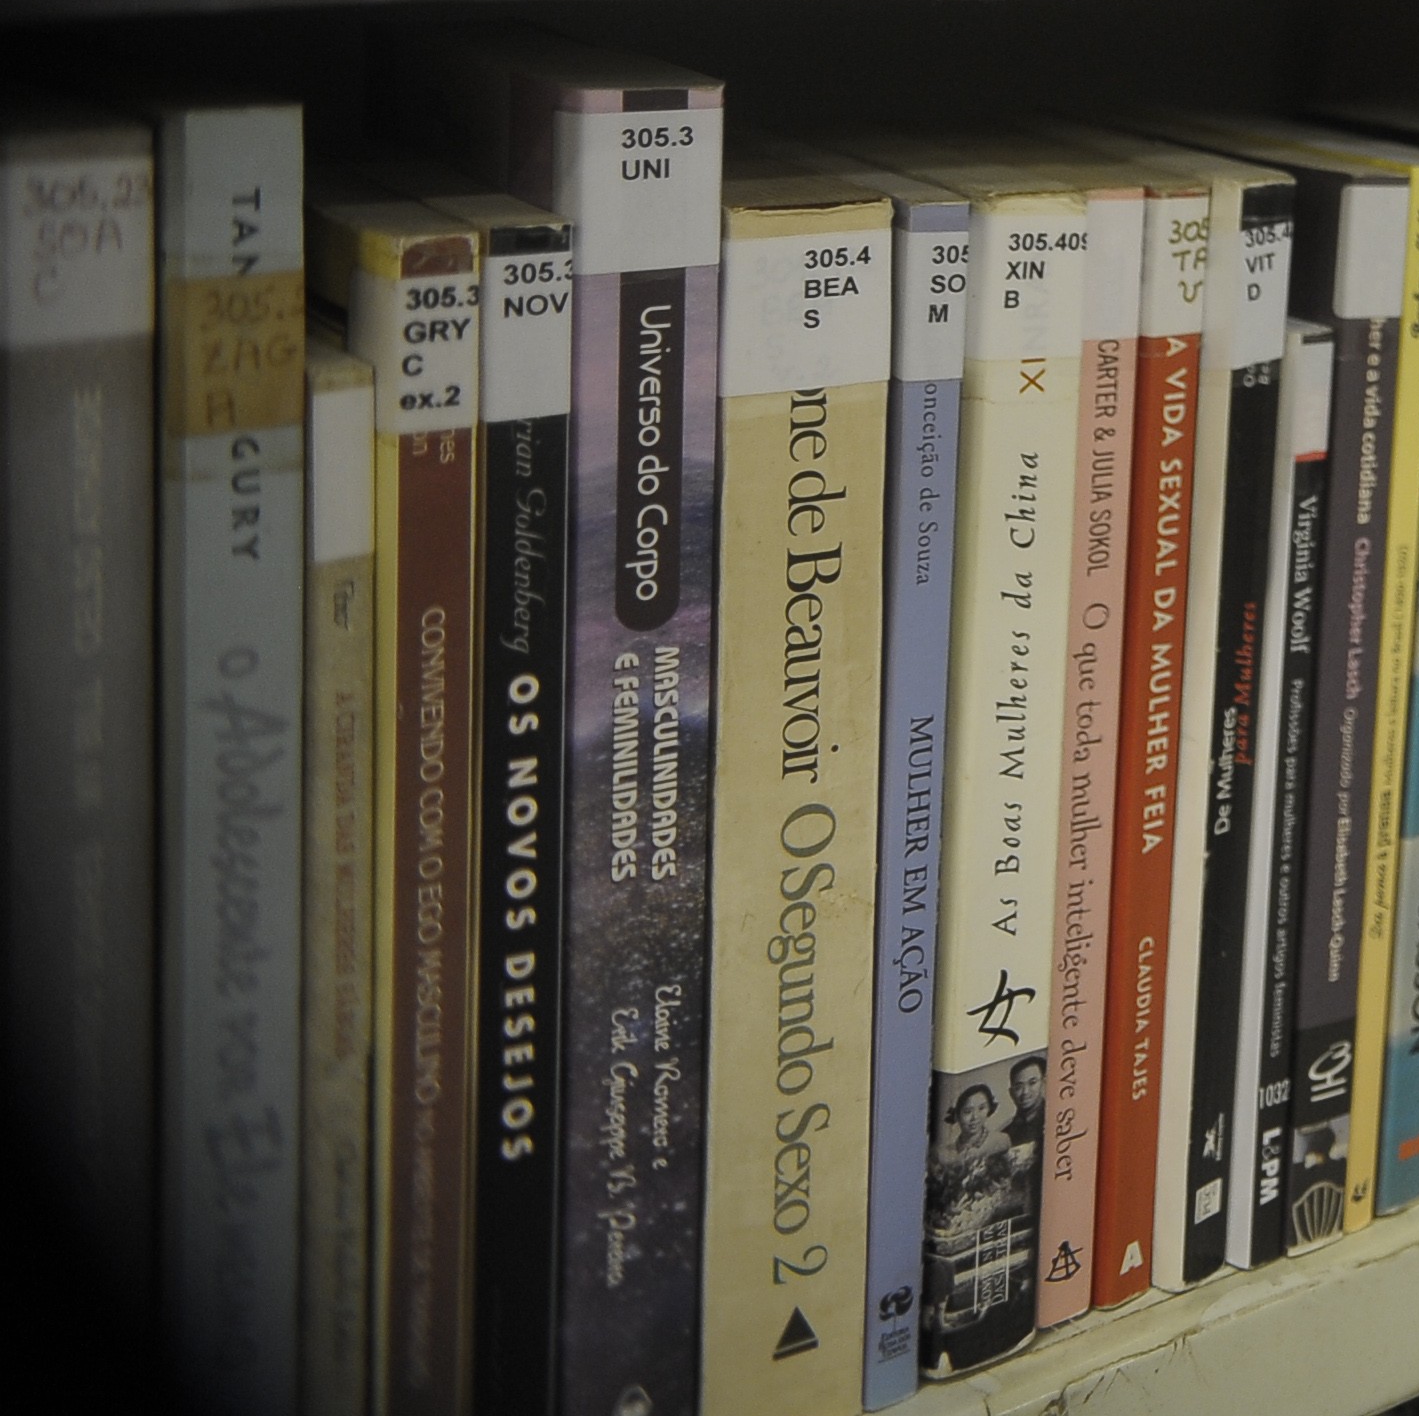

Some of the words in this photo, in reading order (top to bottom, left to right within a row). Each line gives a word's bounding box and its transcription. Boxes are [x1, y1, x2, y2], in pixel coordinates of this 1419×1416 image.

[620, 125, 695, 150] 305.3
[621, 157, 672, 182] UNI
[802, 274, 859, 300] BEA
[803, 246, 872, 271] 305.4
[1004, 260, 1046, 281] XIN
[1244, 252, 1276, 276] VIT
[405, 284, 480, 311] 305.3
[503, 291, 571, 320] NOV
[802, 308, 821, 331] S
[927, 303, 950, 324] M
[1003, 289, 1021, 309] B
[1246, 282, 1261, 303] D
[401, 318, 472, 345] GRY
[1164, 335, 1183, 358] A
[401, 351, 425, 378] C
[638, 305, 673, 448] Universo
[1090, 338, 1119, 418] CARTER
[399, 384, 462, 412] ex.2
[1159, 366, 1187, 448] VIDA
[1361, 385, 1382, 430] vida
[1090, 425, 1116, 442] &
[637, 454, 671, 496] do
[785, 469, 848, 538] de
[919, 487, 941, 512] de
[1001, 452, 1040, 549] China
[1088, 448, 1115, 502] JULIA
[1356, 431, 1379, 526] cotidiana
[1086, 505, 1114, 574] SOKOL
[1154, 459, 1184, 578] SEXUAL
[1292, 493, 1320, 584] Virginia
[499, 487, 547, 654] Goldenberg
[624, 502, 670, 602] Corpo
[916, 521, 939, 587] Souza
[1000, 570, 1034, 610] da
[1082, 598, 1112, 626] O
[1151, 589, 1177, 634] DA
[1289, 586, 1314, 655] Woolf
[611, 651, 640, 671] E
[780, 541, 843, 783] Beauvoir
[1071, 638, 1097, 695] que
[1233, 601, 1258, 707] Mulheres
[506, 673, 539, 736] OS
[993, 628, 1034, 780] Mulheres
[1072, 698, 1103, 763] toda
[1144, 643, 1173, 775] MULHER
[610, 675, 640, 883] FEMINILIDADES
[650, 645, 681, 882] MASCULINIDADES
[1214, 706, 1239, 801] Mulheres
[1282, 755, 1299, 791] para
[903, 714, 935, 859] MULHER
[504, 755, 539, 932] NOVOS
[779, 804, 838, 859] O
[993, 801, 1022, 877] Boas
[1066, 769, 1104, 868] mulher
[1140, 785, 1168, 854] FEIA
[1213, 803, 1233, 836] De
[1280, 792, 1297, 862] mulheres
[416, 884, 443, 944] EGO
[901, 863, 929, 916] EM
[989, 897, 1020, 938] As
[766, 862, 836, 1096] Segundo
[892, 924, 928, 1014] AÇÃO
[1057, 879, 1095, 1030] inteligente
[1133, 935, 1155, 1033] CLAUDIA
[499, 950, 537, 1164] DESEJOS
[1059, 1038, 1088, 1101] deve
[1130, 1036, 1152, 1101] TAJES
[1258, 1077, 1292, 1110] 1032
[772, 1102, 832, 1236] Sexo
[1053, 1107, 1089, 1183] saber
[772, 1243, 829, 1284] 2
